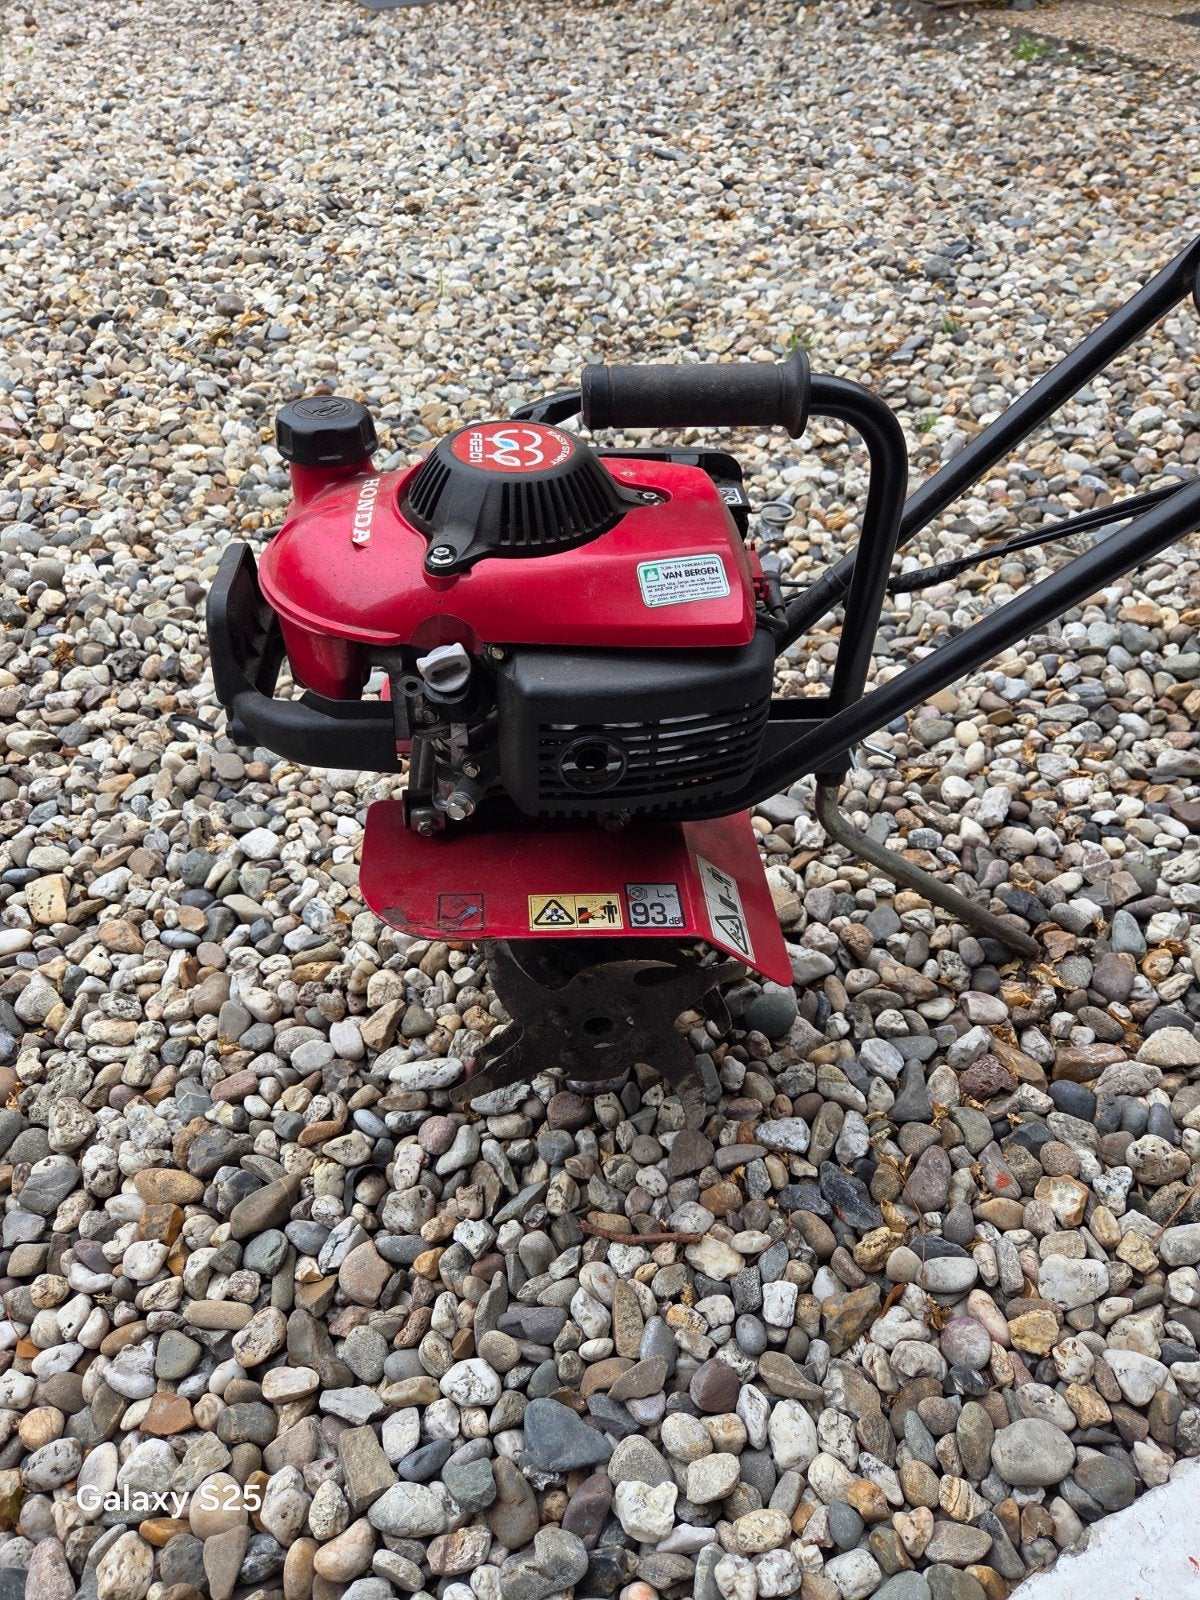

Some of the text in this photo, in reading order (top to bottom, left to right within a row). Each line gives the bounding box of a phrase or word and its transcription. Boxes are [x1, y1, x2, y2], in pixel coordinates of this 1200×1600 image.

[469, 432, 483, 463] FG201
[546, 430, 571, 465] EASY START
[352, 477, 380, 543] HONDA
[662, 566, 719, 580] VAN BERGEN
[631, 902, 681, 925] 93 dB
